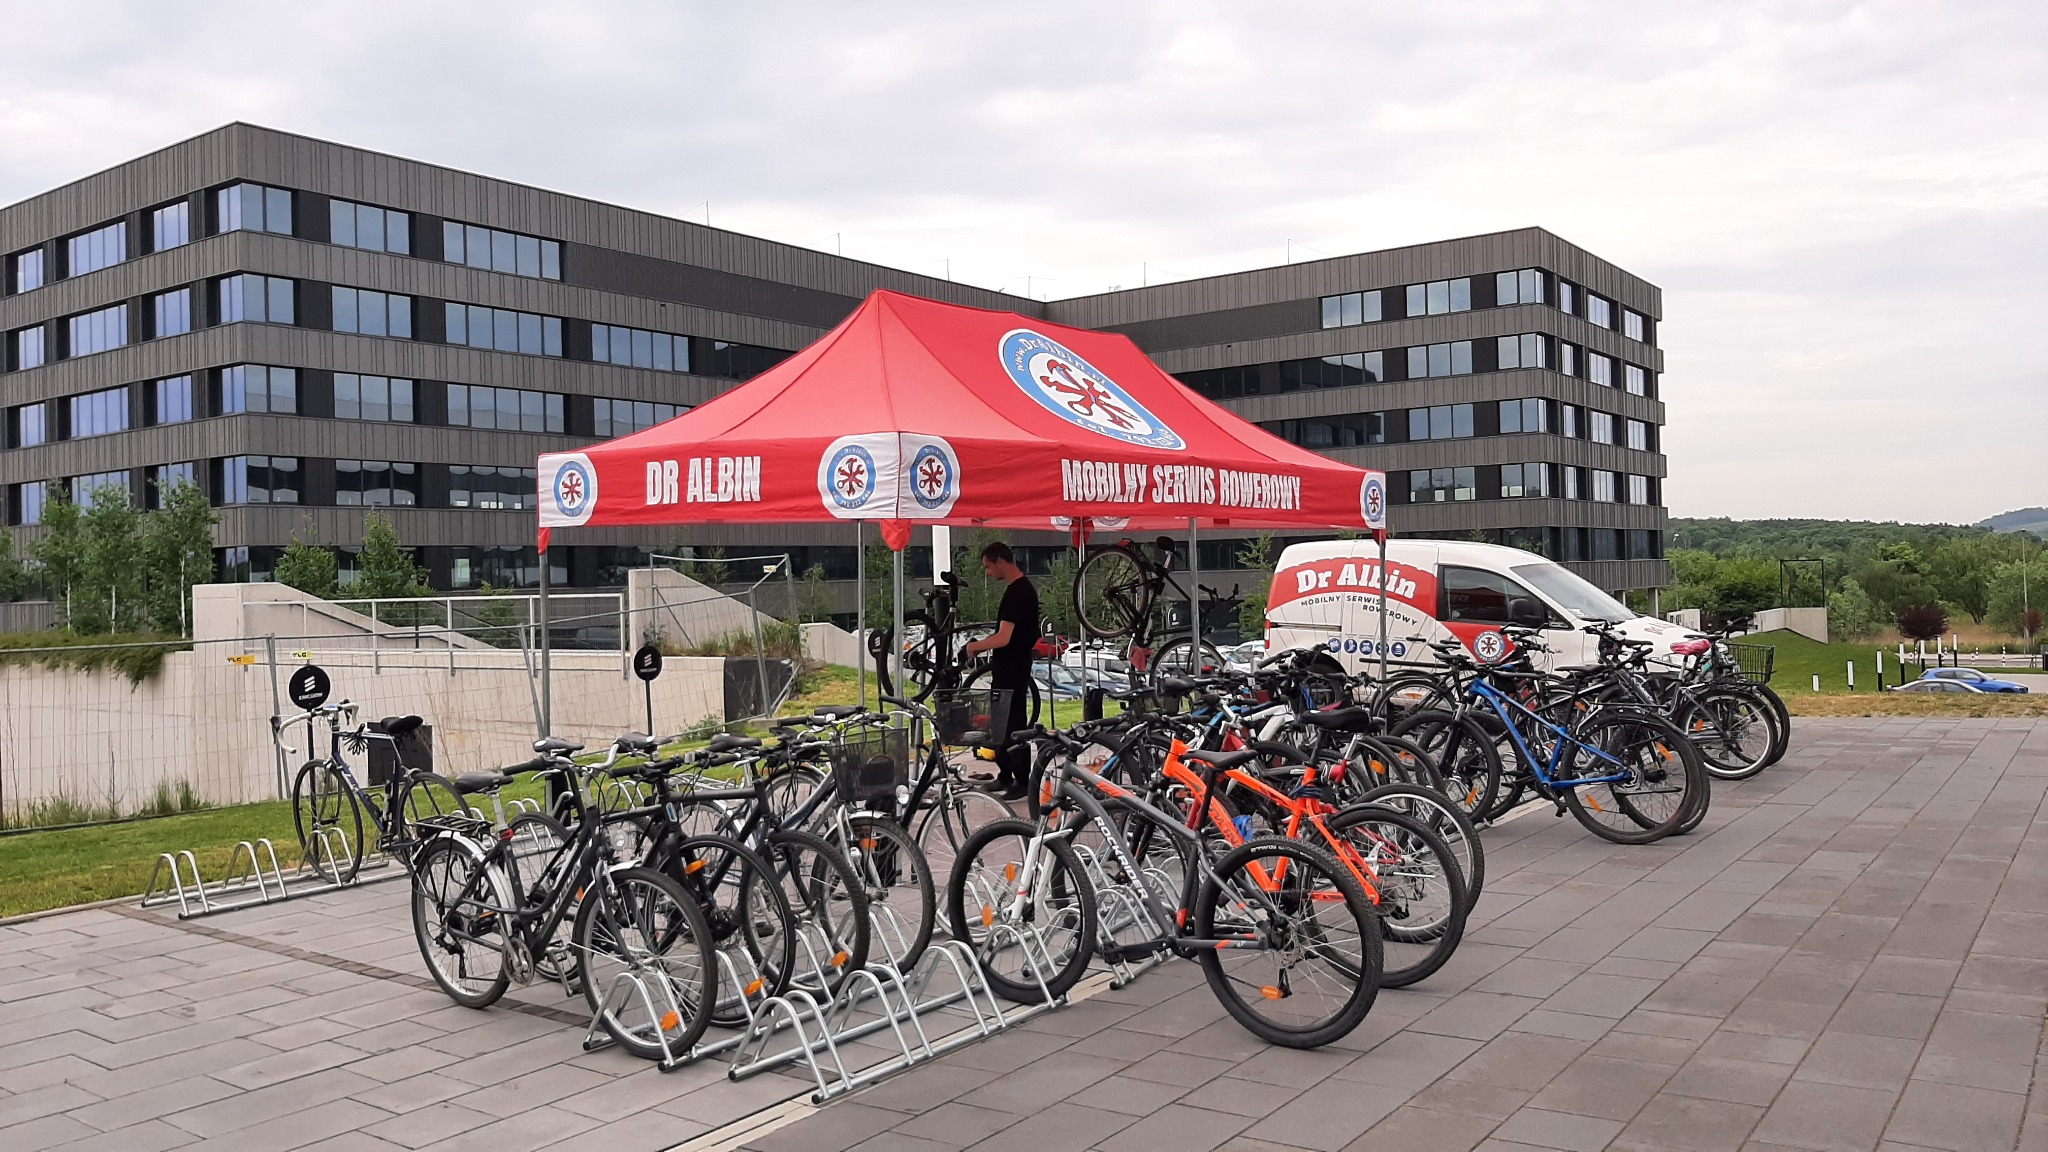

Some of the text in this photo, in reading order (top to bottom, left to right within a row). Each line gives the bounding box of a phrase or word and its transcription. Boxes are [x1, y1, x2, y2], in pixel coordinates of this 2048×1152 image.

[645, 455, 762, 506] DR ALBIN
[1060, 458, 1301, 511] MOBILNY SERWIS ROWEROWY
[1296, 563, 1417, 599] Dr Albin
[1300, 595, 1381, 607] MOBILNY SERWIS
[1093, 815, 1149, 900] ROCKRIDER
